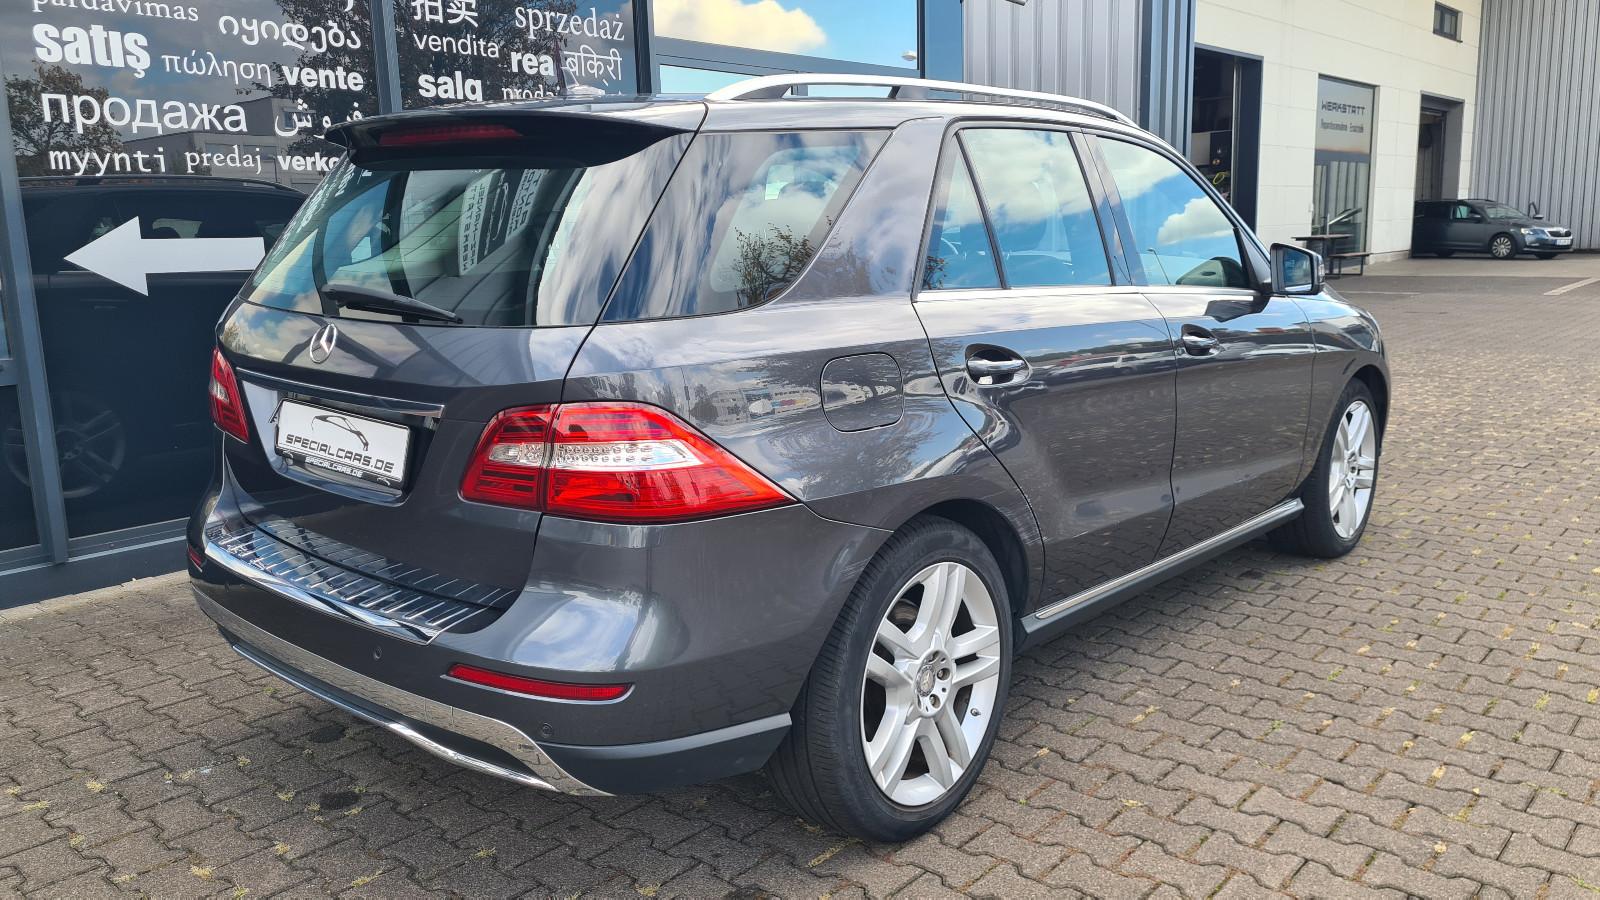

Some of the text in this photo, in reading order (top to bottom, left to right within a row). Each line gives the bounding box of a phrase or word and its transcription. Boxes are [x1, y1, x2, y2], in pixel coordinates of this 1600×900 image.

[218, 15, 362, 53] იყიდება
[514, 6, 625, 41] sprzedaż
[32, 23, 151, 79] satış
[413, 33, 499, 59] vendita
[161, 50, 271, 88] πώληση
[281, 65, 364, 92] vente
[510, 51, 555, 76] rea
[501, 84, 561, 100] prod
[1321, 100, 1365, 115] WERKSTATT
[40, 93, 248, 135] продажа
[49, 146, 166, 177] myynti
[184, 144, 262, 175] predaj
[285, 434, 394, 473] SPECIALCARS.DE
